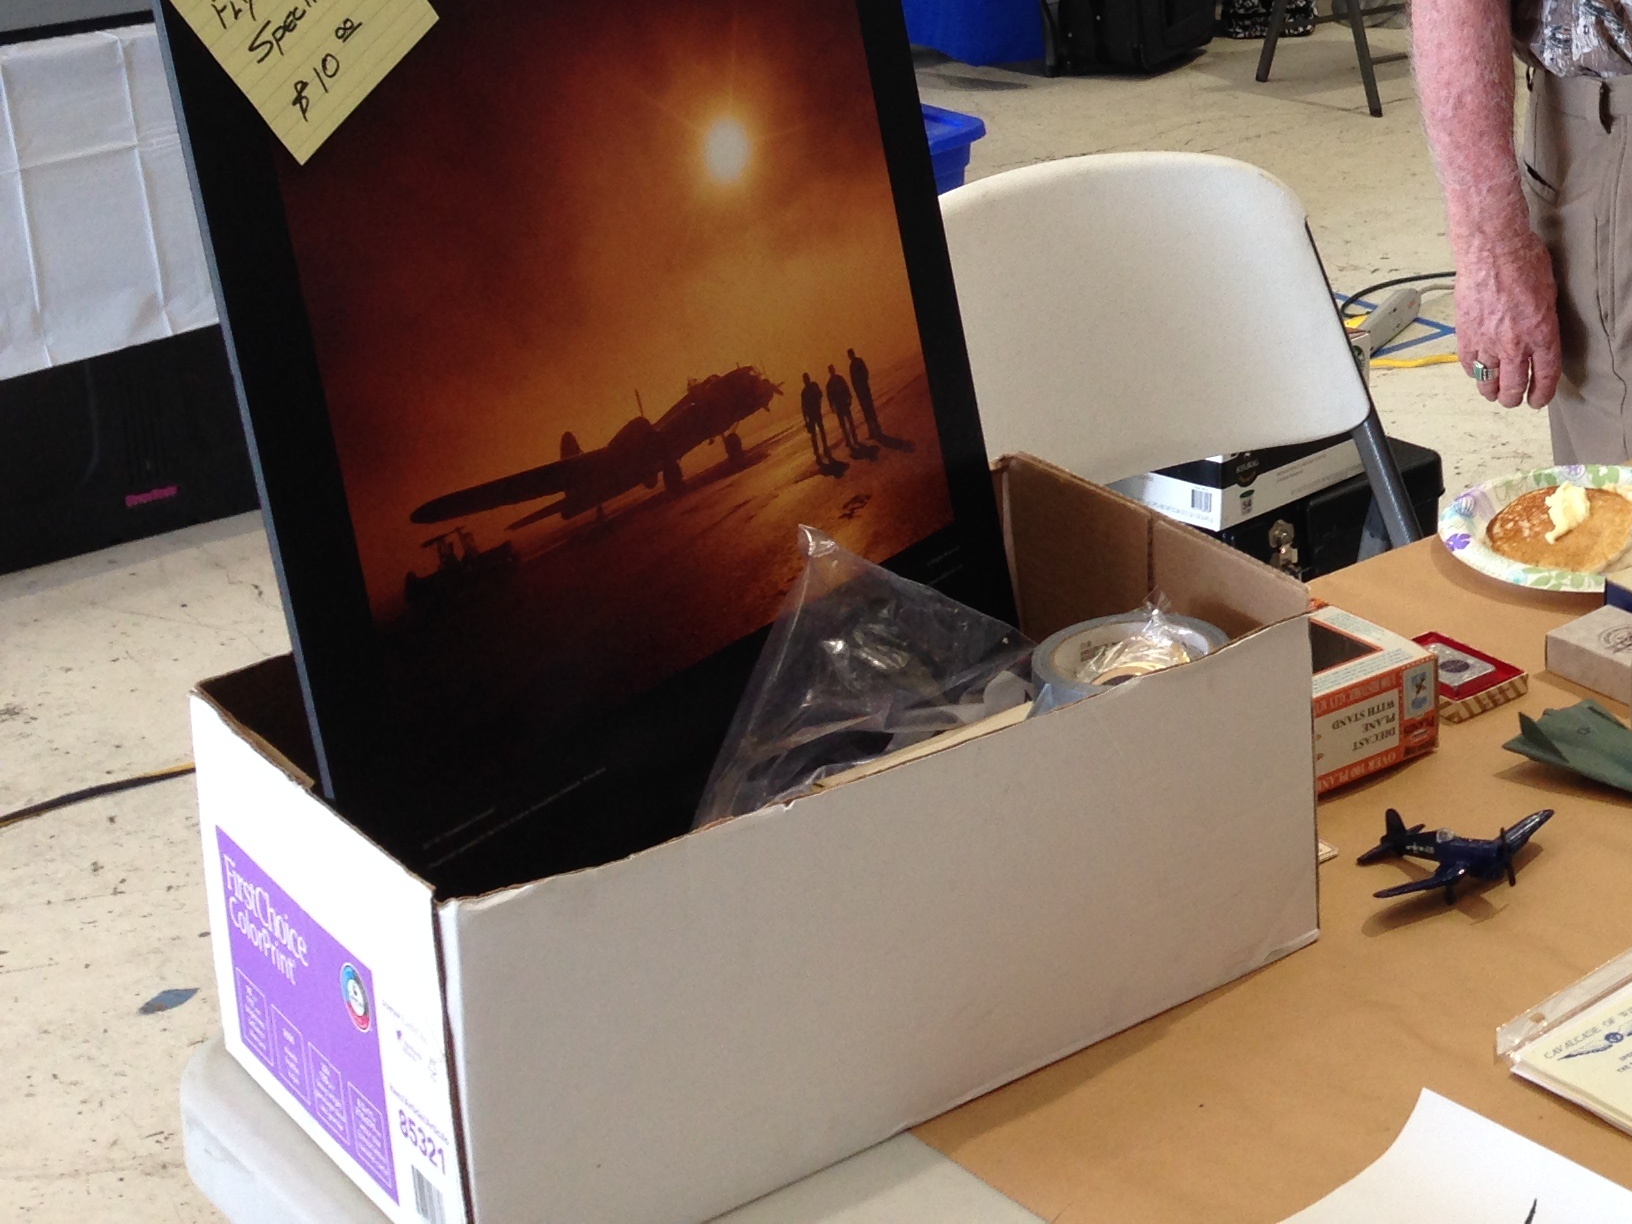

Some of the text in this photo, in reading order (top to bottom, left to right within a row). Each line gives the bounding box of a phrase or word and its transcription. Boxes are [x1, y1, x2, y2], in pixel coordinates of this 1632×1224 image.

[1331, 699, 1395, 731] WITH STAND
[1361, 712, 1396, 734] PLANE
[1351, 726, 1396, 752] DIECAST
[223, 853, 309, 968] FirstChoice
[228, 895, 297, 986] ColorPrint
[1543, 1025, 1602, 1061] CAVALCADE
[1603, 1015, 1619, 1027] OF
[398, 1108, 447, 1176] 85321
